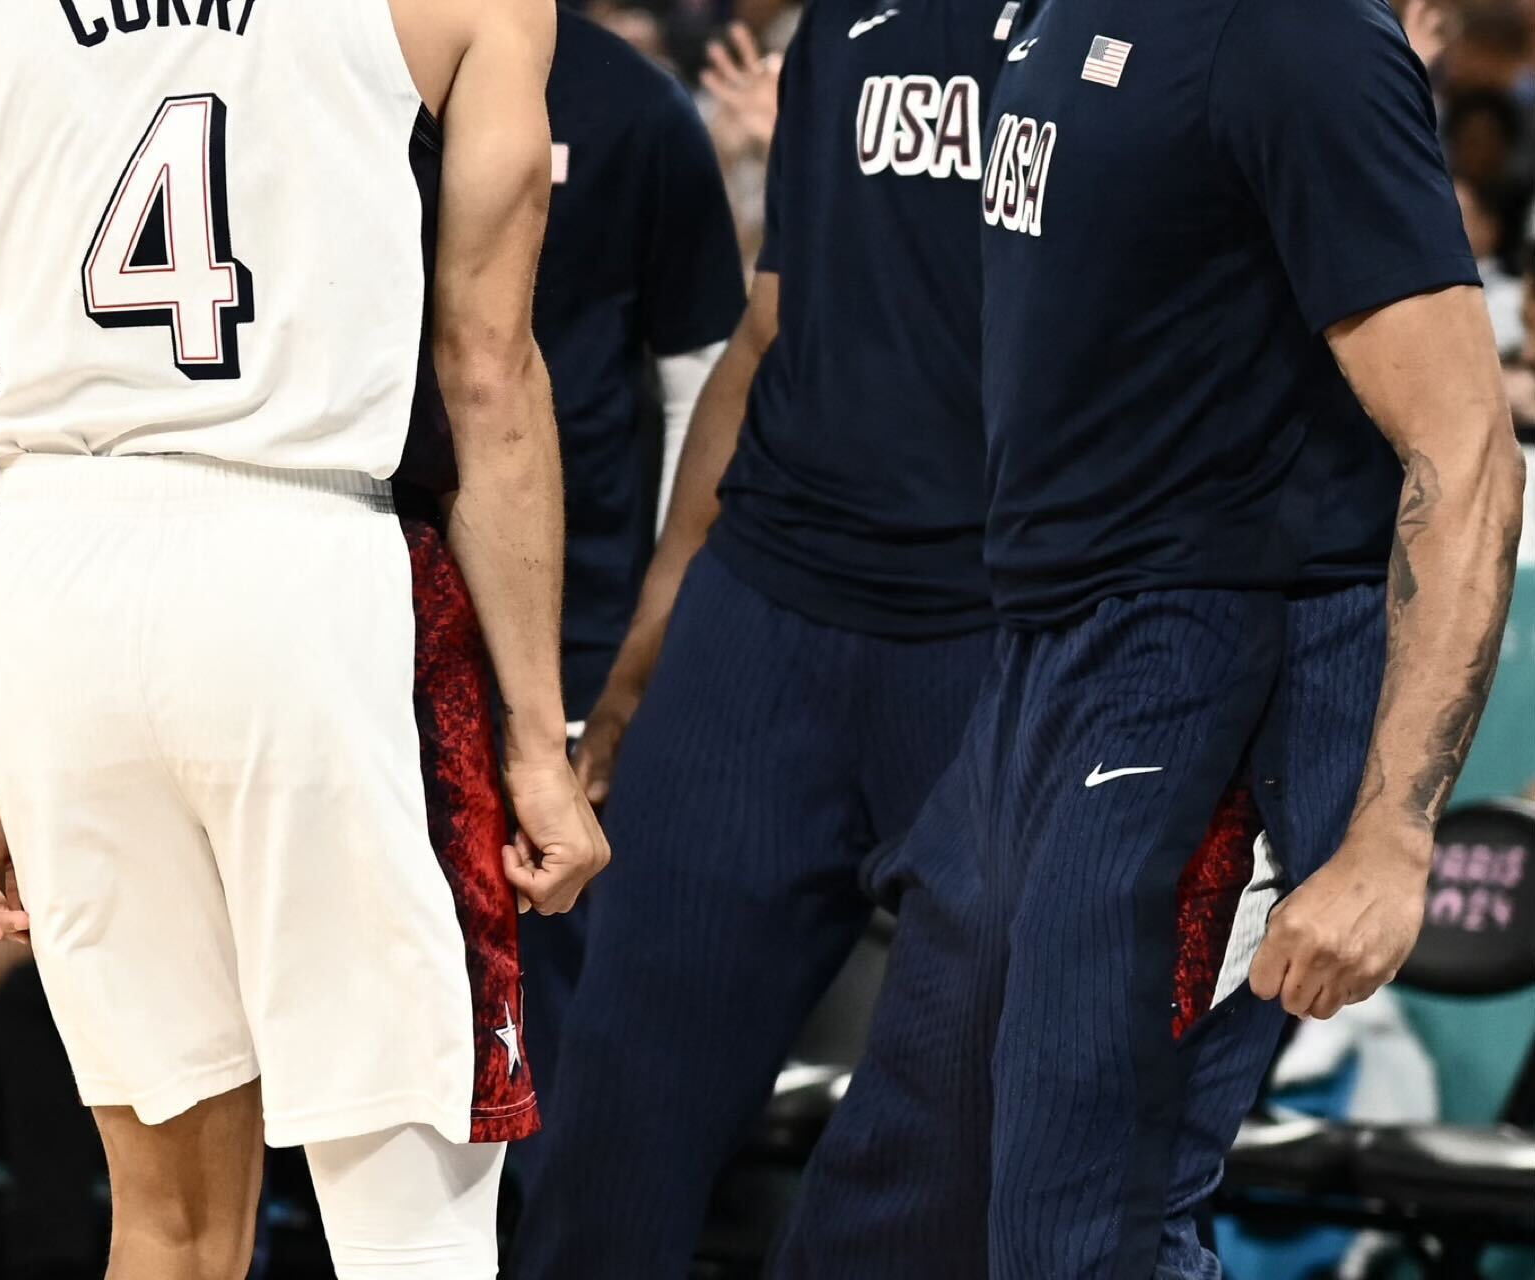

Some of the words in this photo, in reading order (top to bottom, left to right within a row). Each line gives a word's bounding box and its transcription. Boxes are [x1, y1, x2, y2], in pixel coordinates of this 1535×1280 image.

[856, 74, 982, 180] USA
[982, 113, 1057, 237] USA
[81, 92, 255, 380] 4
[1427, 886, 1513, 932] 024
[1433, 843, 1528, 888] ARIS
